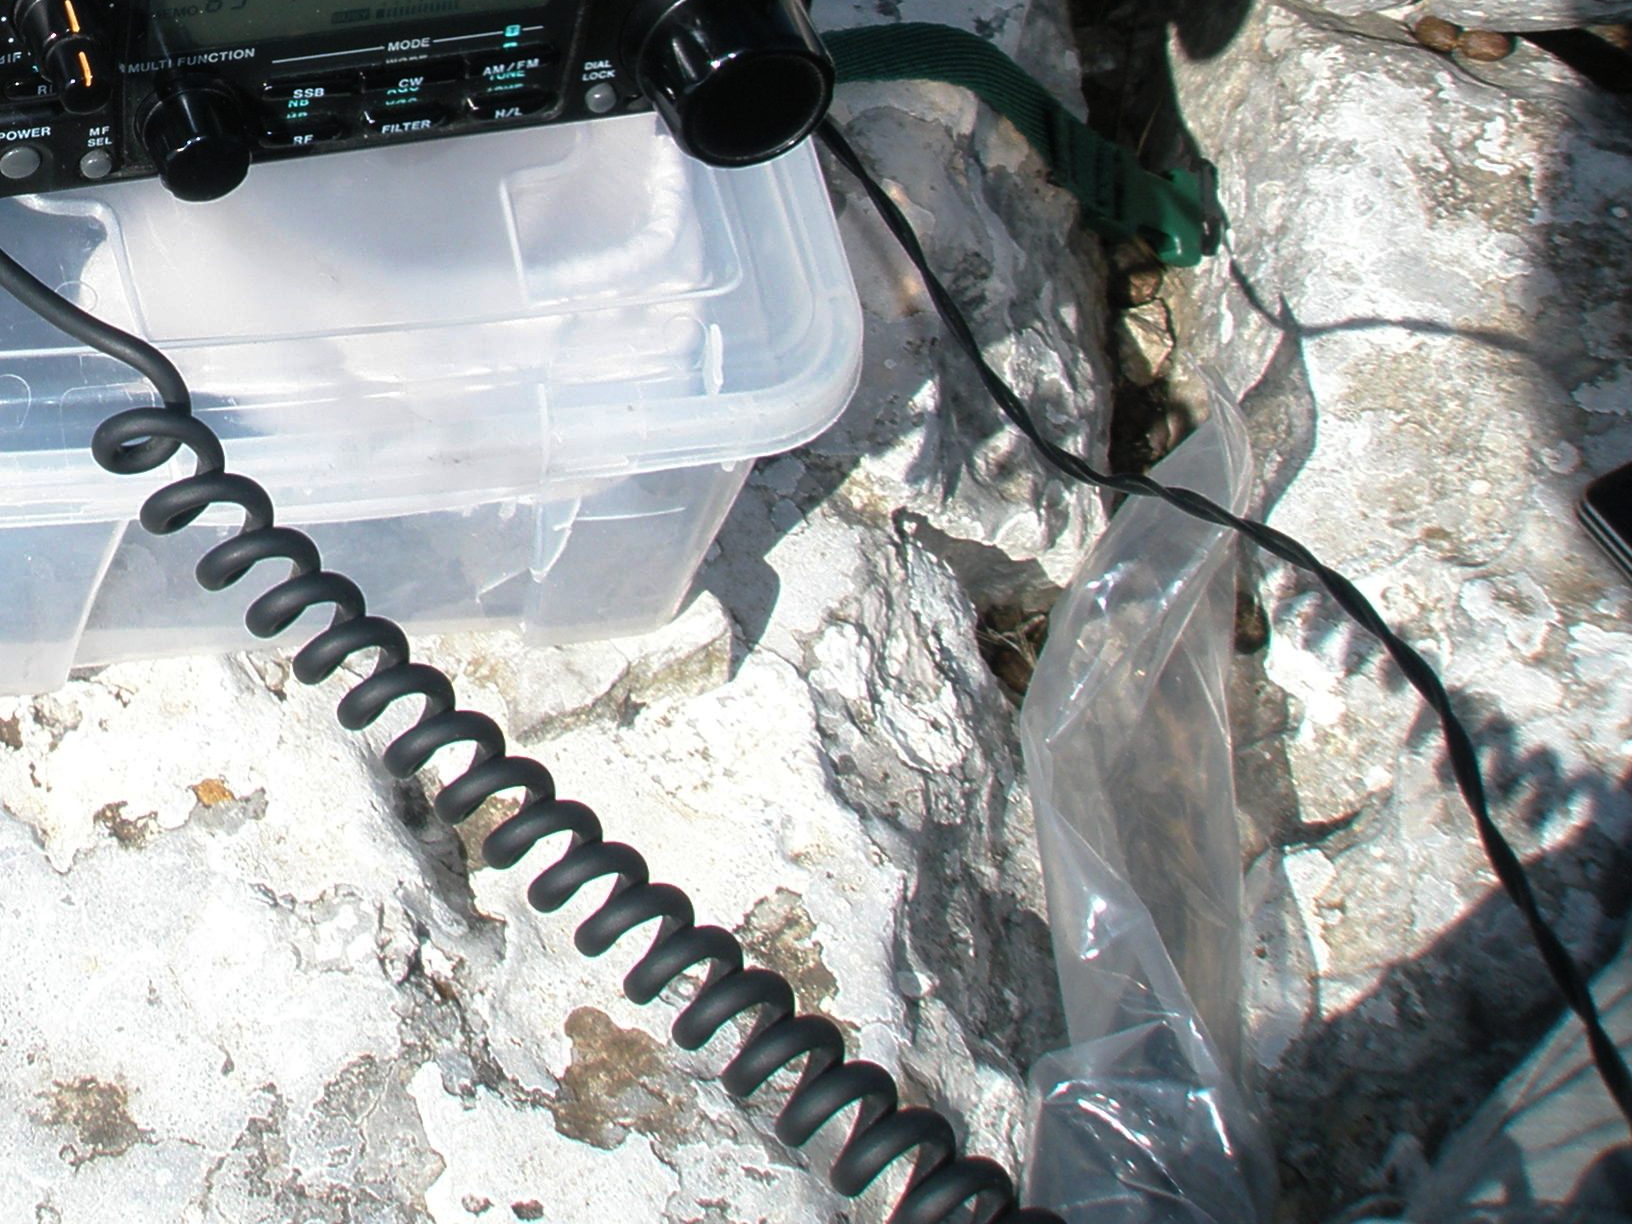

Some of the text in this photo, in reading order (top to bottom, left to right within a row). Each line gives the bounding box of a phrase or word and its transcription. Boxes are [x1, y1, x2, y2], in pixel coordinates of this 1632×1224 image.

[387, 36, 431, 52] MODE
[127, 47, 256, 75] MULTI FUNCTION
[482, 57, 540, 76] AM/FM
[583, 60, 612, 71] DIAL
[397, 75, 425, 88] CW
[581, 70, 616, 82] LOCK
[292, 87, 326, 99] SSB
[89, 126, 110, 136] MF
[381, 118, 432, 134] FILTER
[87, 135, 113, 146] SEL
